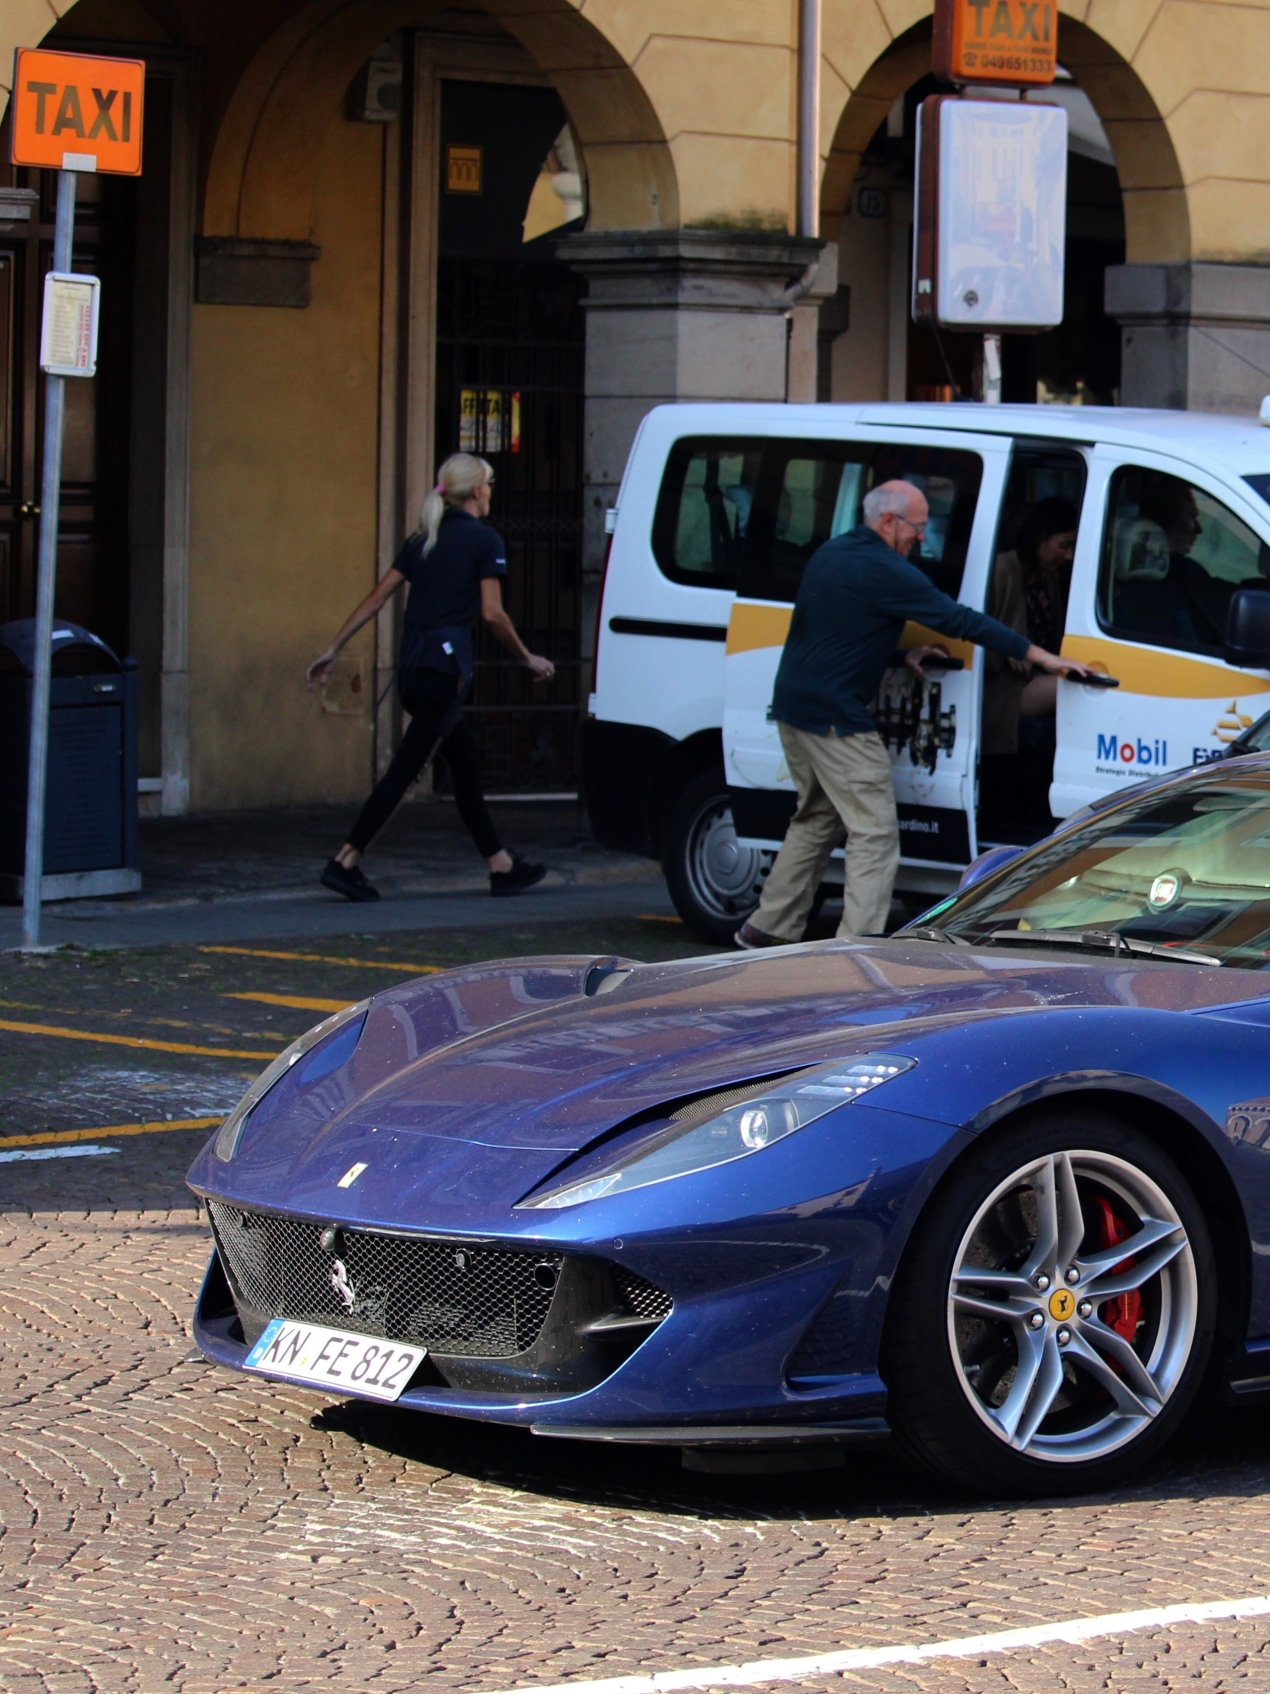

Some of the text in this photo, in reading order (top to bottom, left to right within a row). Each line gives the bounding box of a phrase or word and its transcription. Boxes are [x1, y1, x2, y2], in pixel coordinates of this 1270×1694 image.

[968, 0, 1051, 42] TAXI
[981, 54, 1052, 74] 049651333
[27, 81, 132, 143] TAXI
[1097, 734, 1167, 766] Mobil
[263, 1327, 415, 1390] KN FE 812
